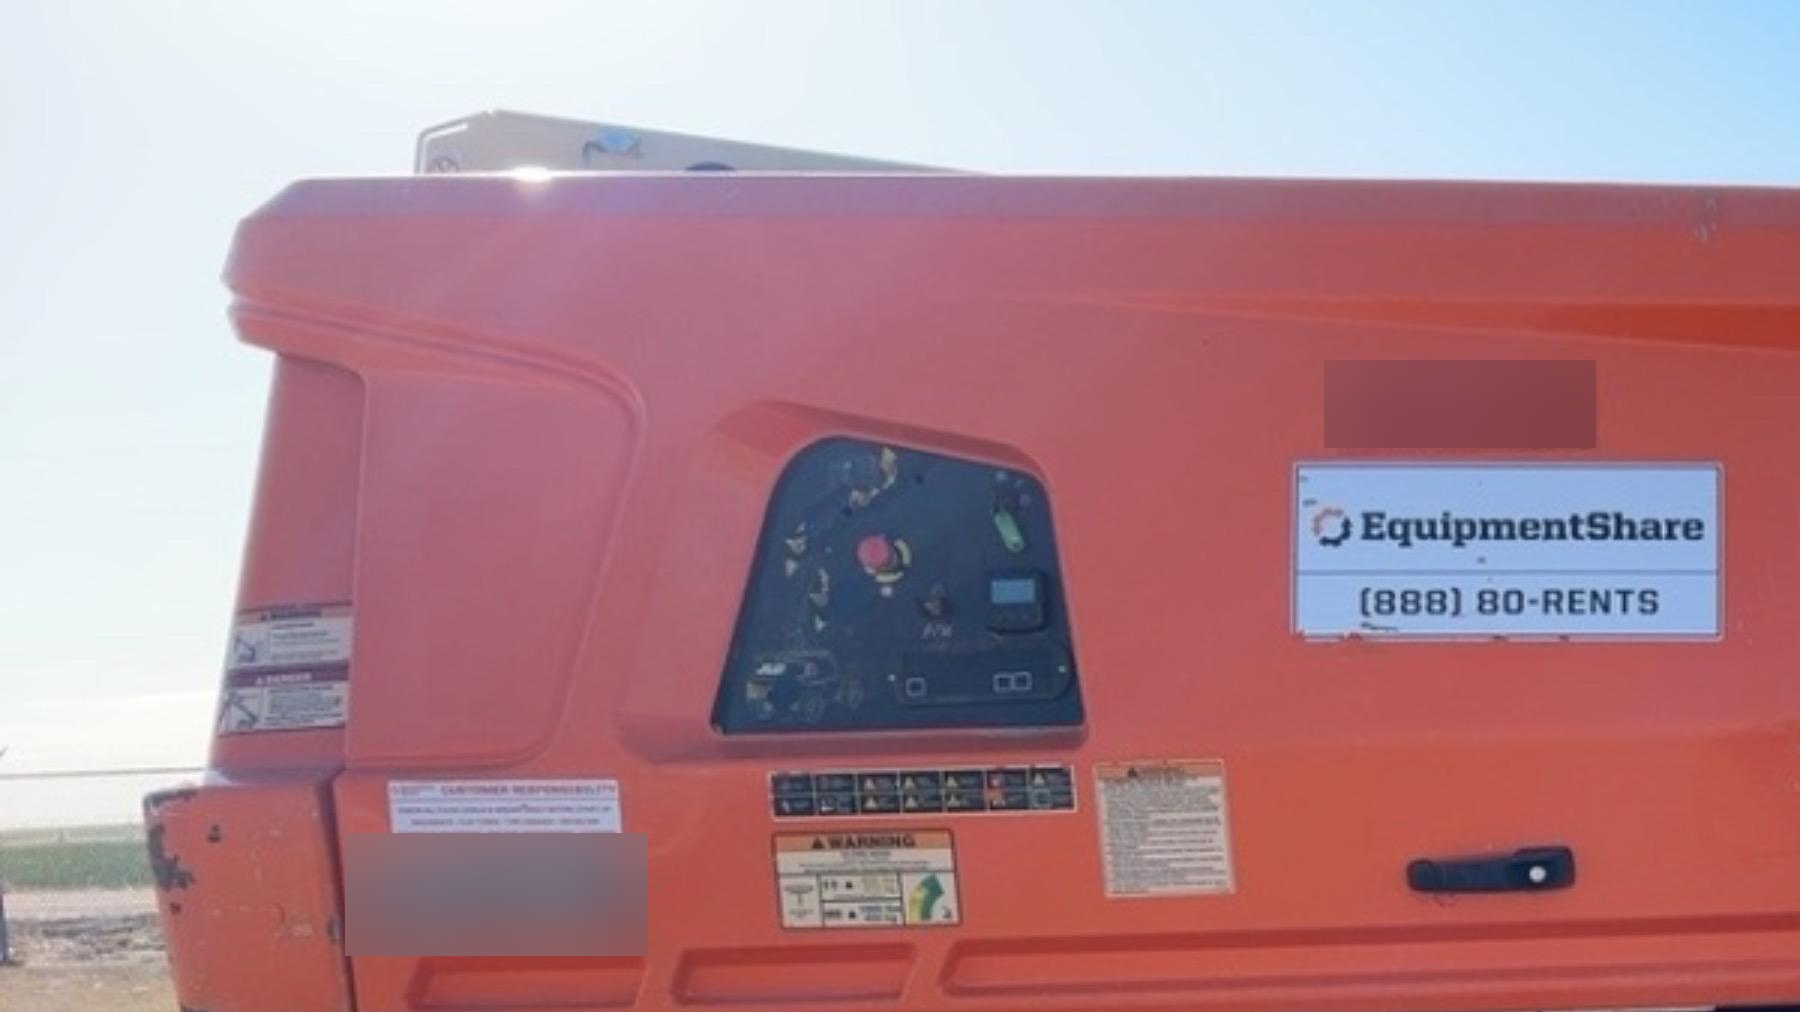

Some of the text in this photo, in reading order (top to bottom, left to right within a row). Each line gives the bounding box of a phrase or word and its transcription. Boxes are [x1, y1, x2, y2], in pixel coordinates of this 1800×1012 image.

[1361, 511, 1705, 548] EquipmentShare
[1360, 587, 1660, 617] (888) 80-RENTS
[829, 835, 916, 850] WARNING
